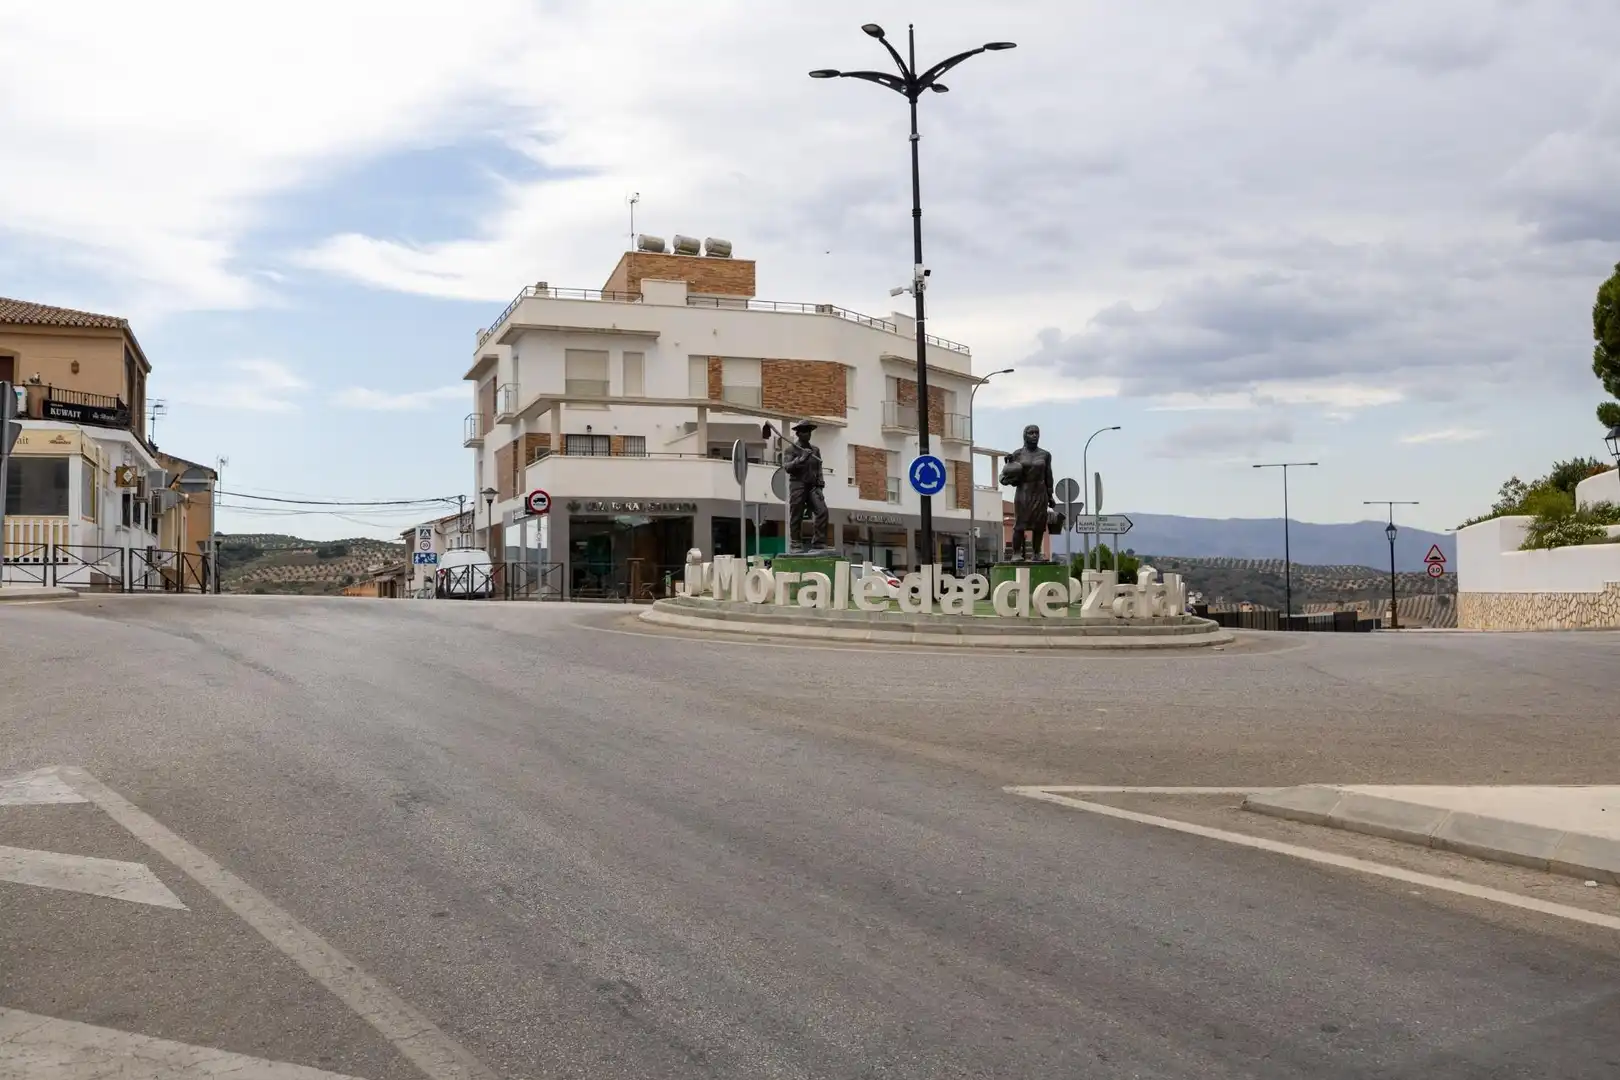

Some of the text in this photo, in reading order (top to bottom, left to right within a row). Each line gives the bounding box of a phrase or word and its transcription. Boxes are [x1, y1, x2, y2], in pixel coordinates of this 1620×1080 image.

[50, 407, 82, 418] KUWAIT
[713, 555, 974, 616] Moraleda
[993, 568, 1068, 618] de
